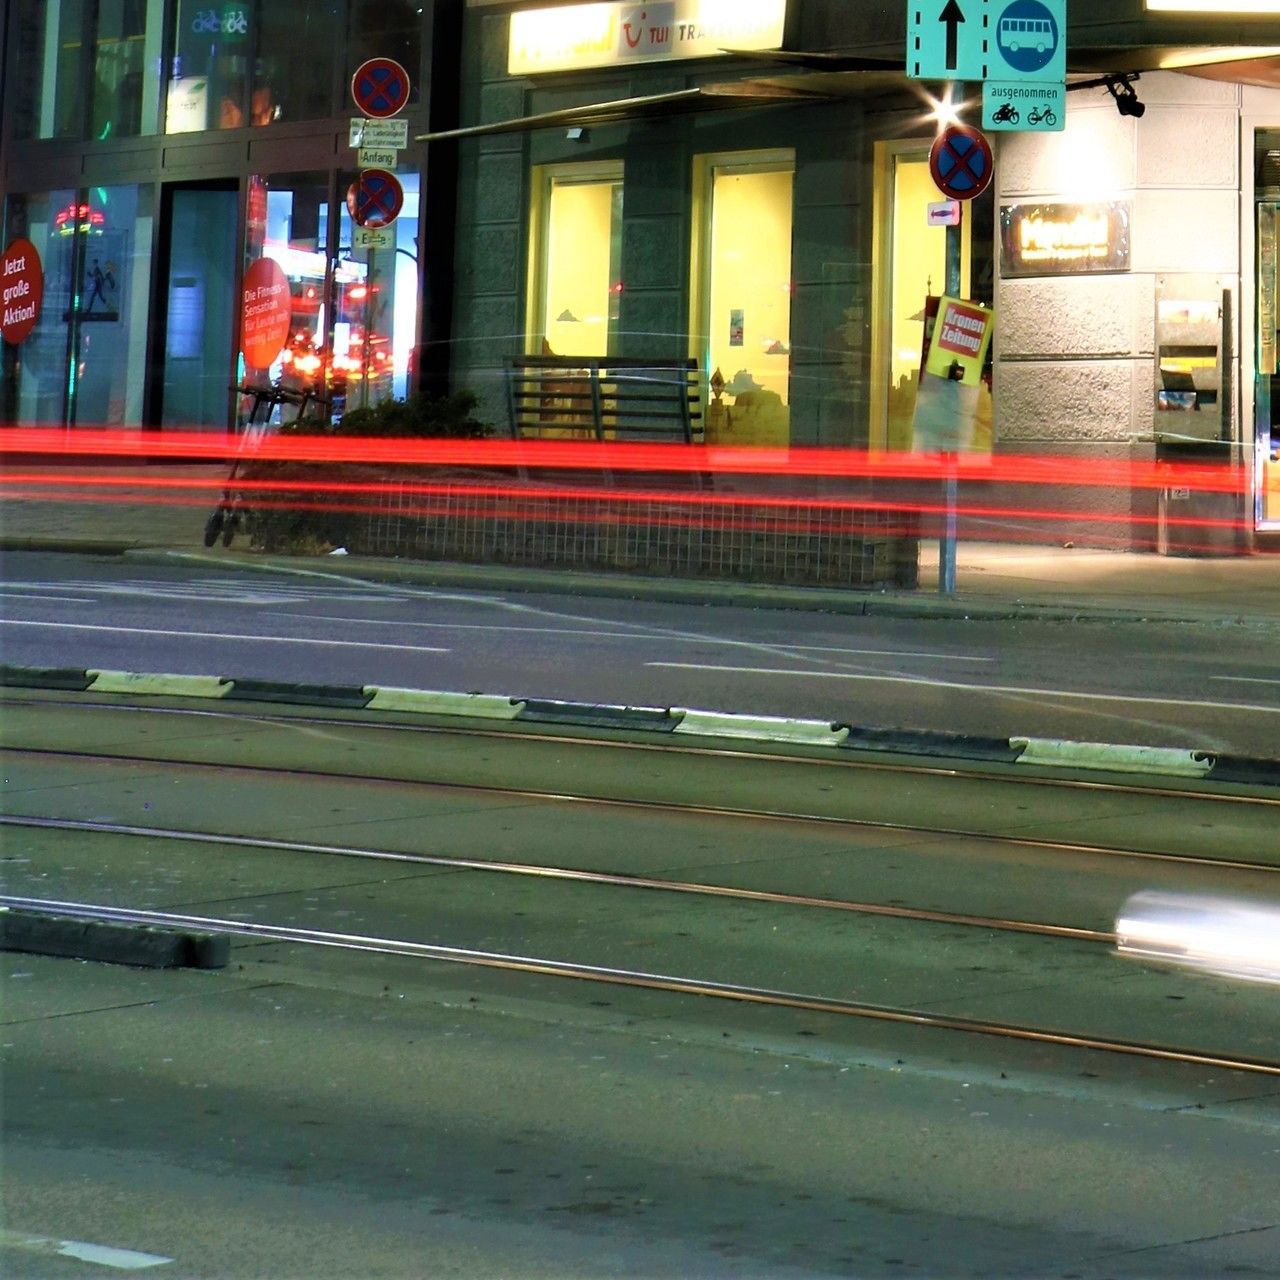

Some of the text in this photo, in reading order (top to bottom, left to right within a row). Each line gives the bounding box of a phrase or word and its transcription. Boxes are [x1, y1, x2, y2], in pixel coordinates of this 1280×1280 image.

[649, 26, 669, 45] TUI
[991, 87, 1058, 100] ausgenommen
[363, 151, 393, 165] Anfang
[3, 256, 26, 276] Jetzt
[3, 280, 30, 304] große
[244, 290, 256, 302] Die
[3, 301, 35, 326] Aktion!
[244, 299, 279, 318] Sensation
[944, 307, 986, 334] Kronen
[941, 324, 982, 352] Zeitung
